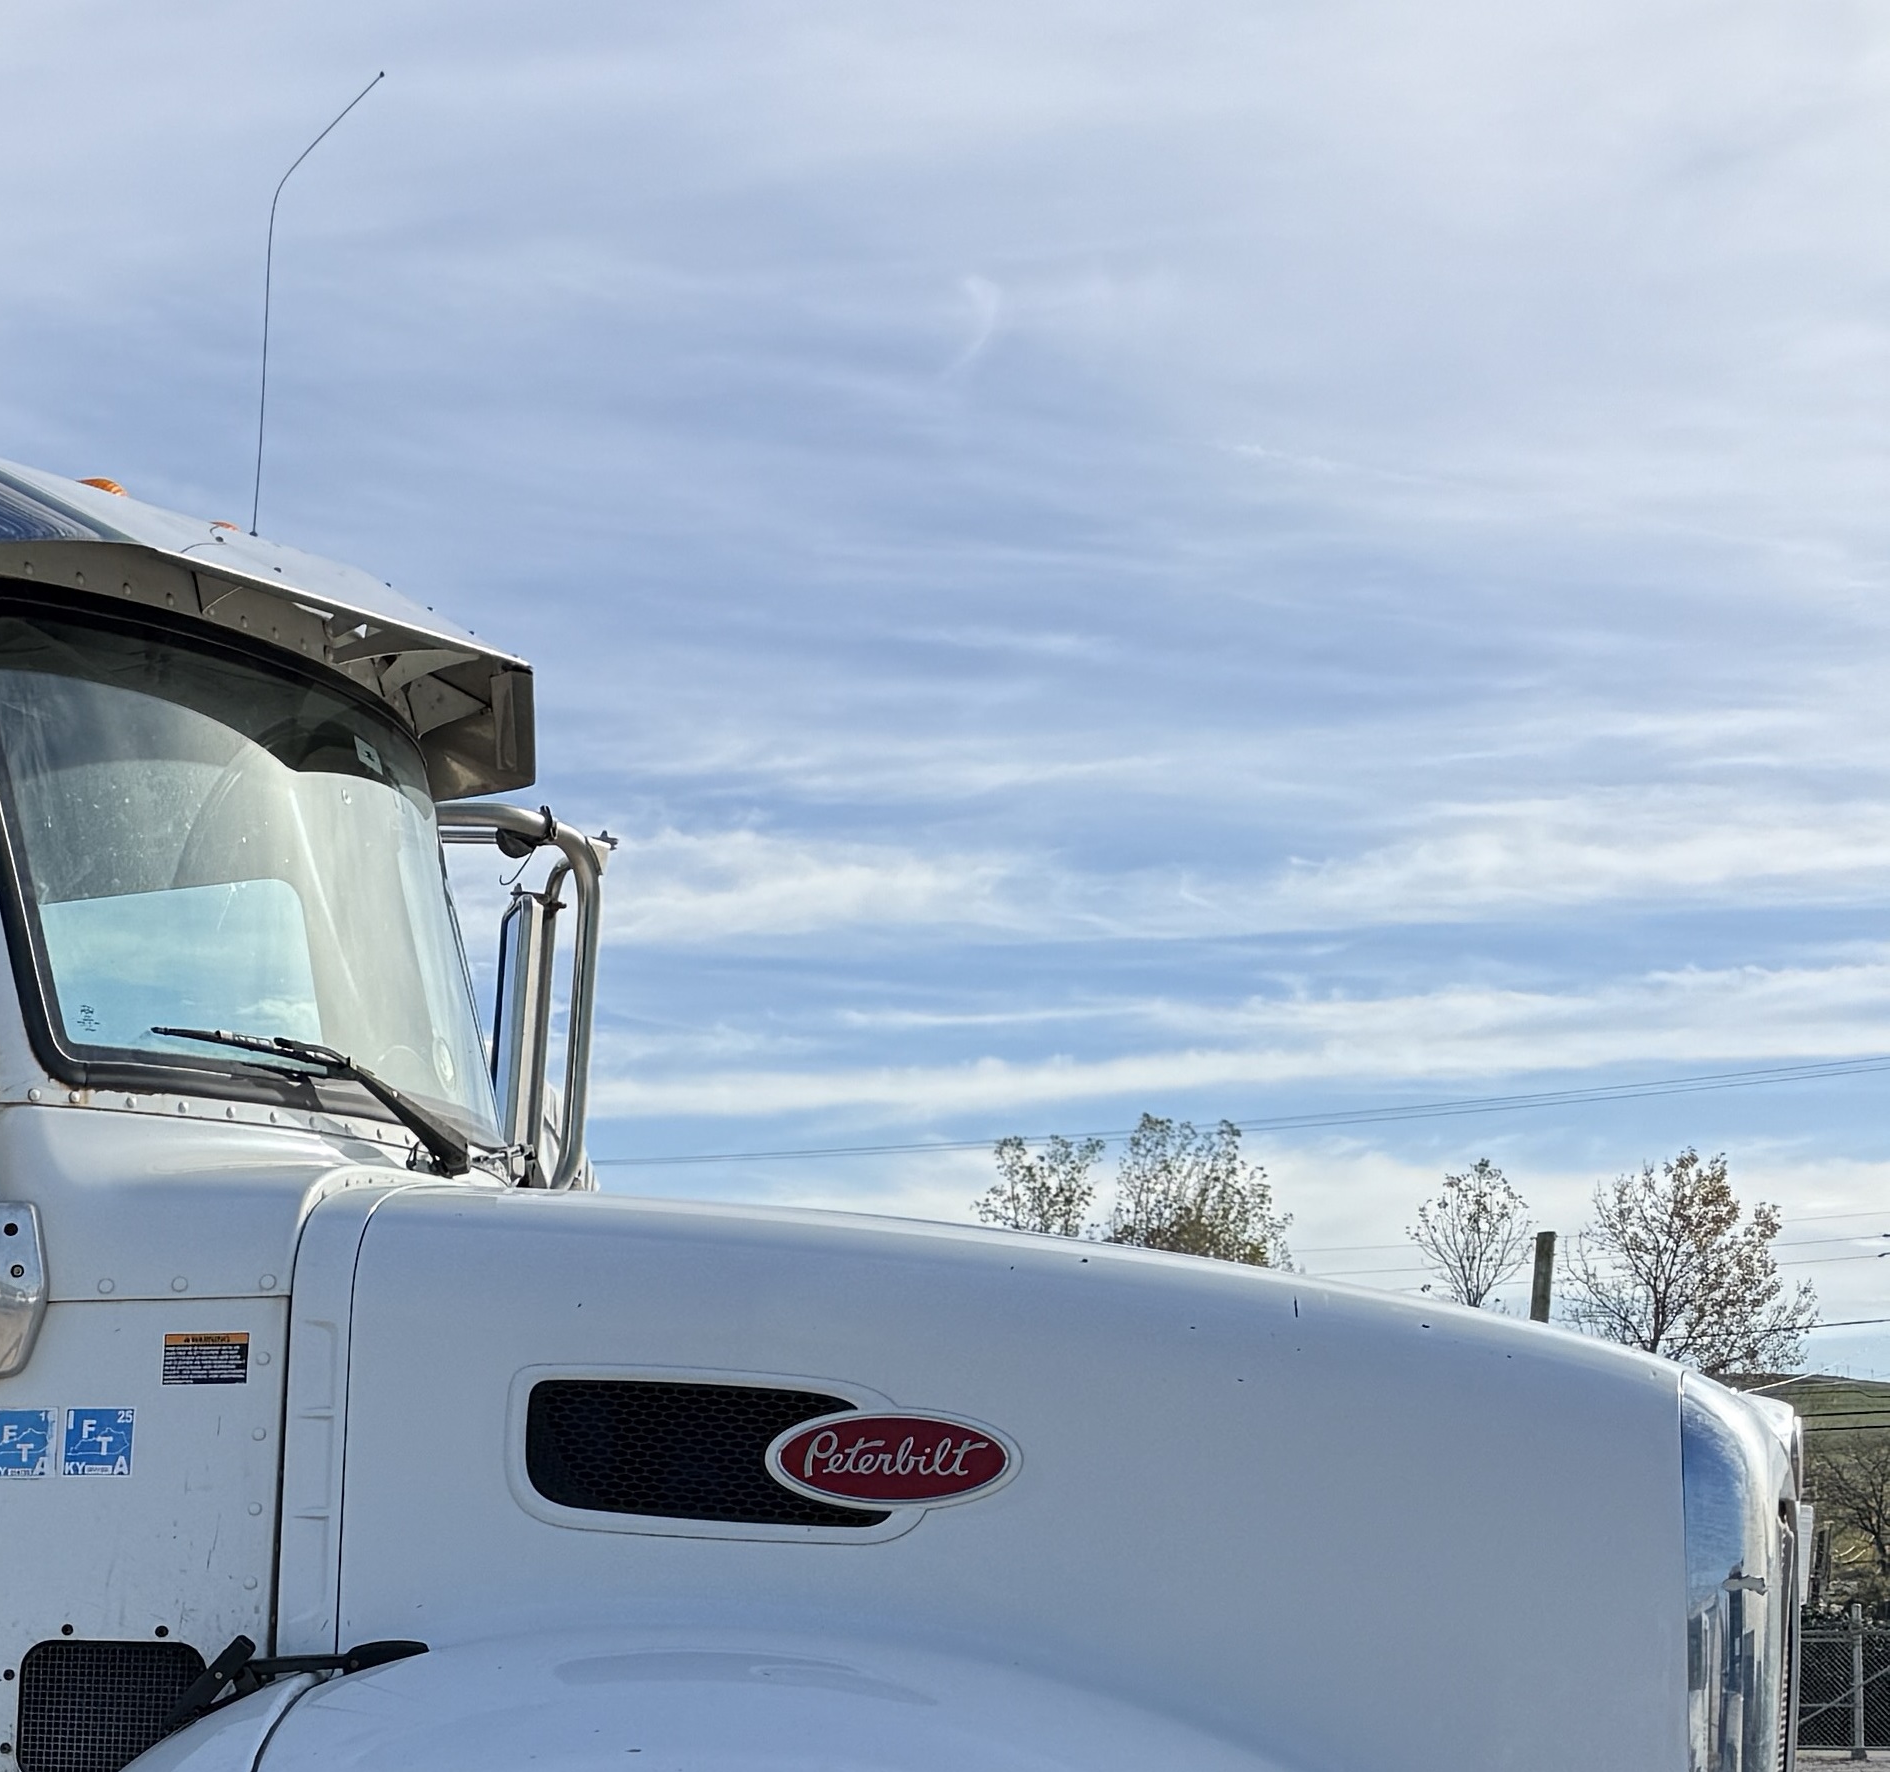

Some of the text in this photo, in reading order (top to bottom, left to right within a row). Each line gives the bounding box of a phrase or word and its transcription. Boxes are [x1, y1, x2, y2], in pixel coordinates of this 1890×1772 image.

[117, 1410, 133, 1423] 25
[804, 1430, 989, 1478] Peterbilt
[65, 1461, 86, 1475] KY
